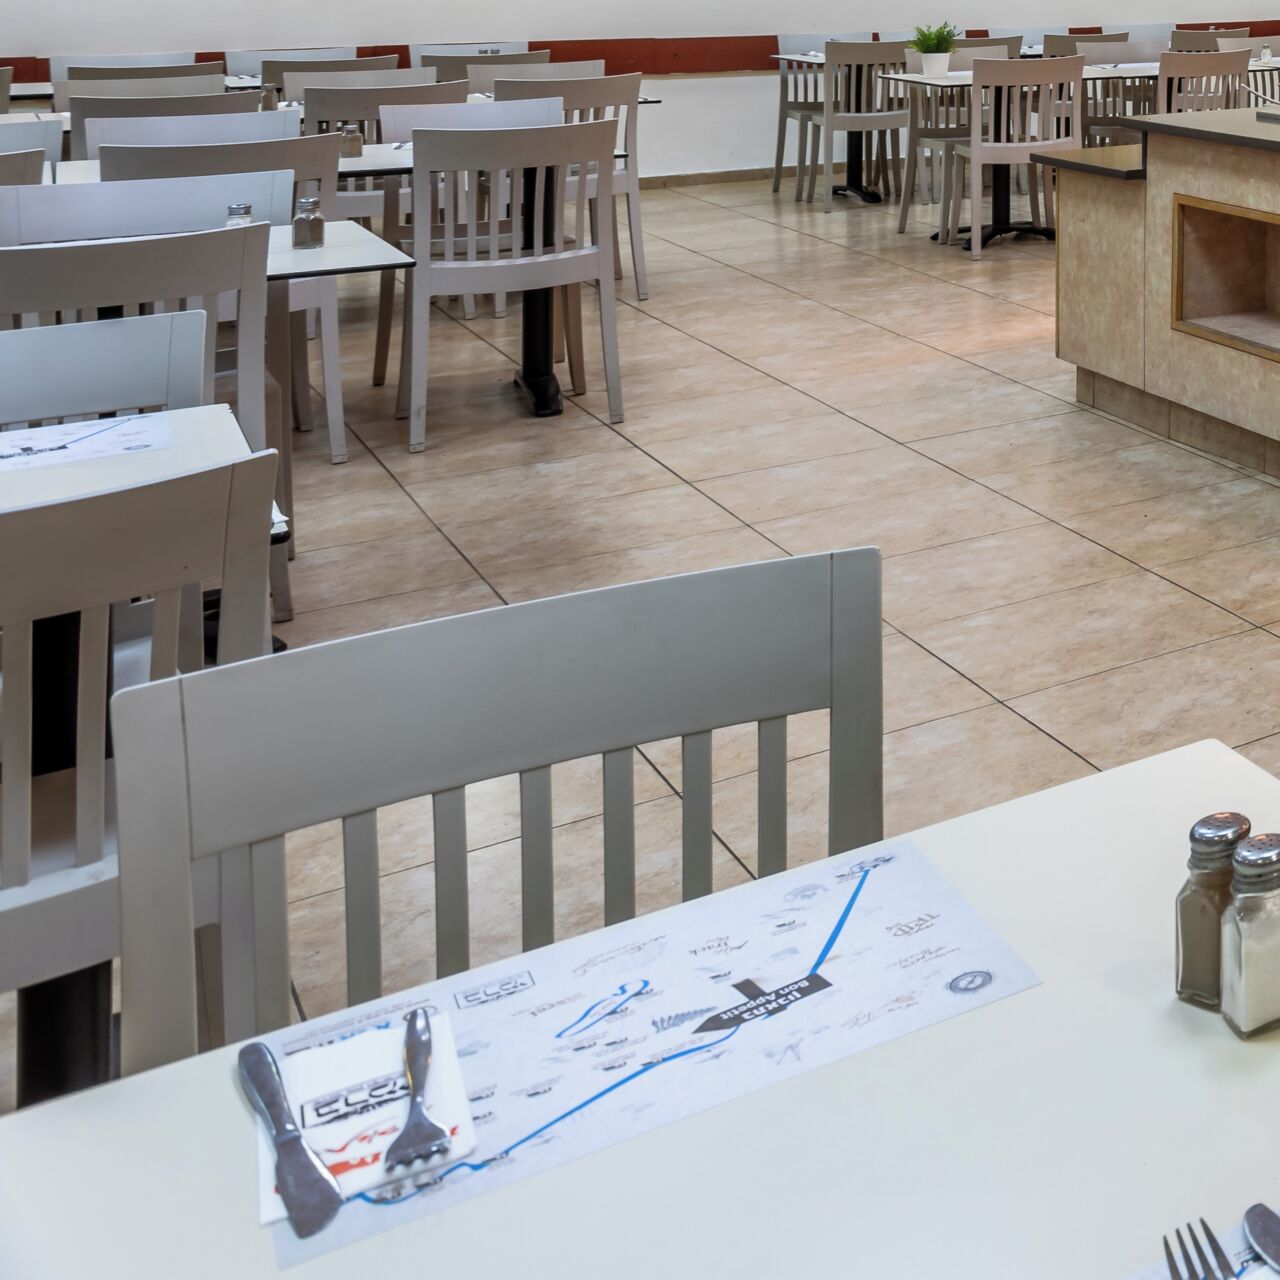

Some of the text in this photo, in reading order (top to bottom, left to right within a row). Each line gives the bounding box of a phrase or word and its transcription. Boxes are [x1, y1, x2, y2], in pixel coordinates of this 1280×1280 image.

[719, 979, 810, 1020] Bon Appetit
[741, 992, 802, 1020] בתאבון
